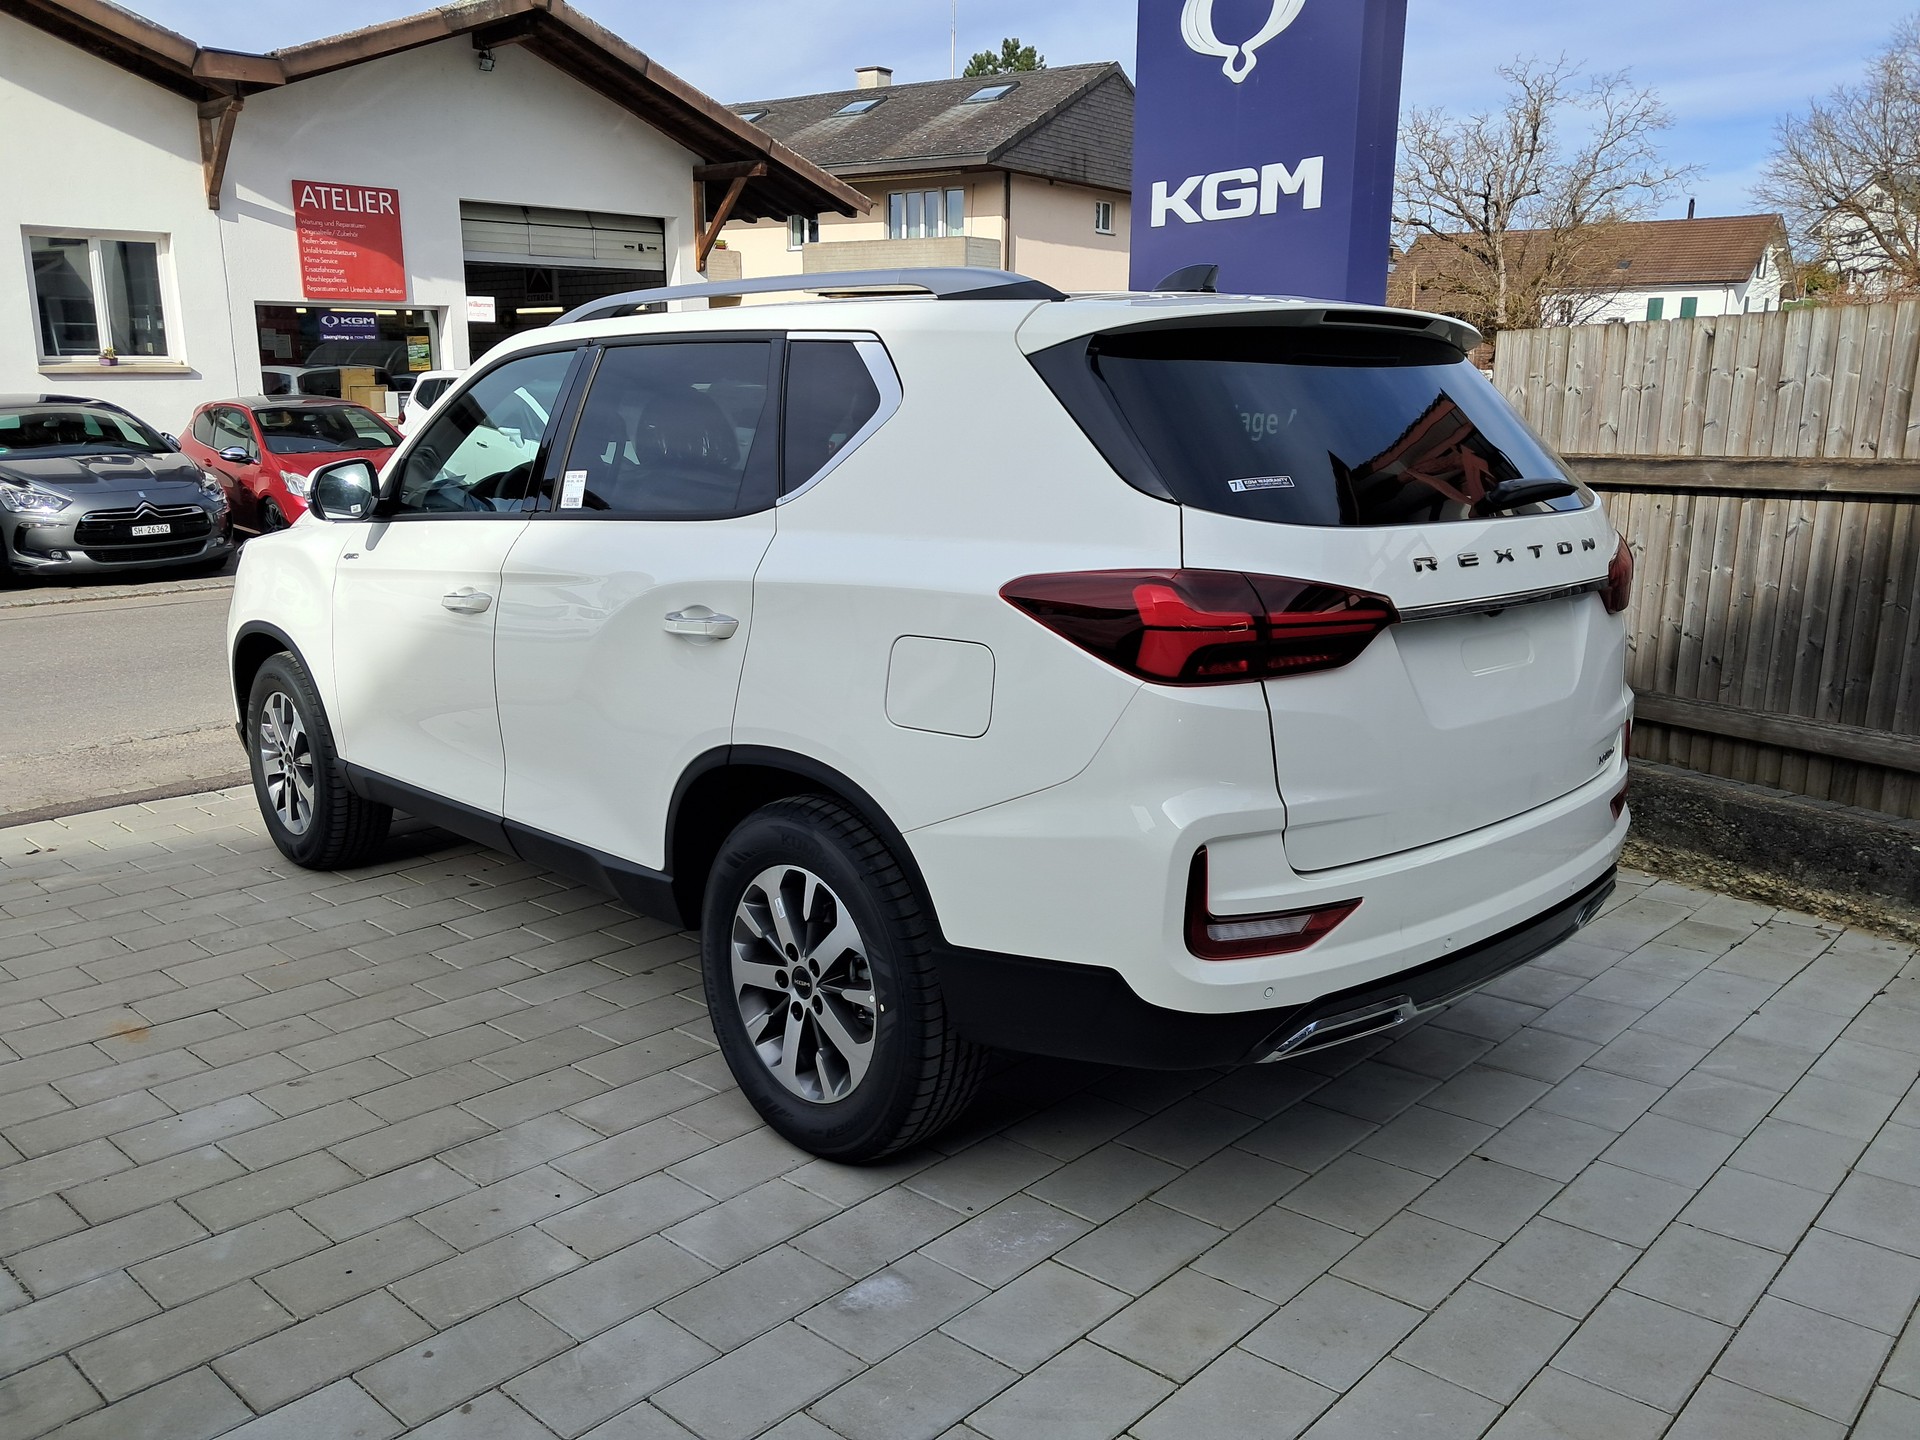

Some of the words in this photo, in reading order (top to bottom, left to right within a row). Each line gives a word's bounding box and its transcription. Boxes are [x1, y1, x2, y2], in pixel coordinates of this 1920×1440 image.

[1150, 155, 1324, 228] KGM
[300, 185, 395, 215] ATELIER
[300, 218, 323, 228] Wartung
[335, 220, 366, 229] Reparaturen
[302, 237, 338, 246] Reifen-Service
[304, 256, 338, 264] Klima-Service
[305, 266, 345, 275] Ersatzfahrzeuge
[307, 285, 338, 293] Reparaturen
[350, 286, 373, 294] Unterhalt
[340, 317, 375, 325] KGM
[133, 527, 143, 535] SH
[147, 525, 169, 534] 26362
[1413, 537, 1596, 573] REXTON
[794, 978, 811, 988] KGM
